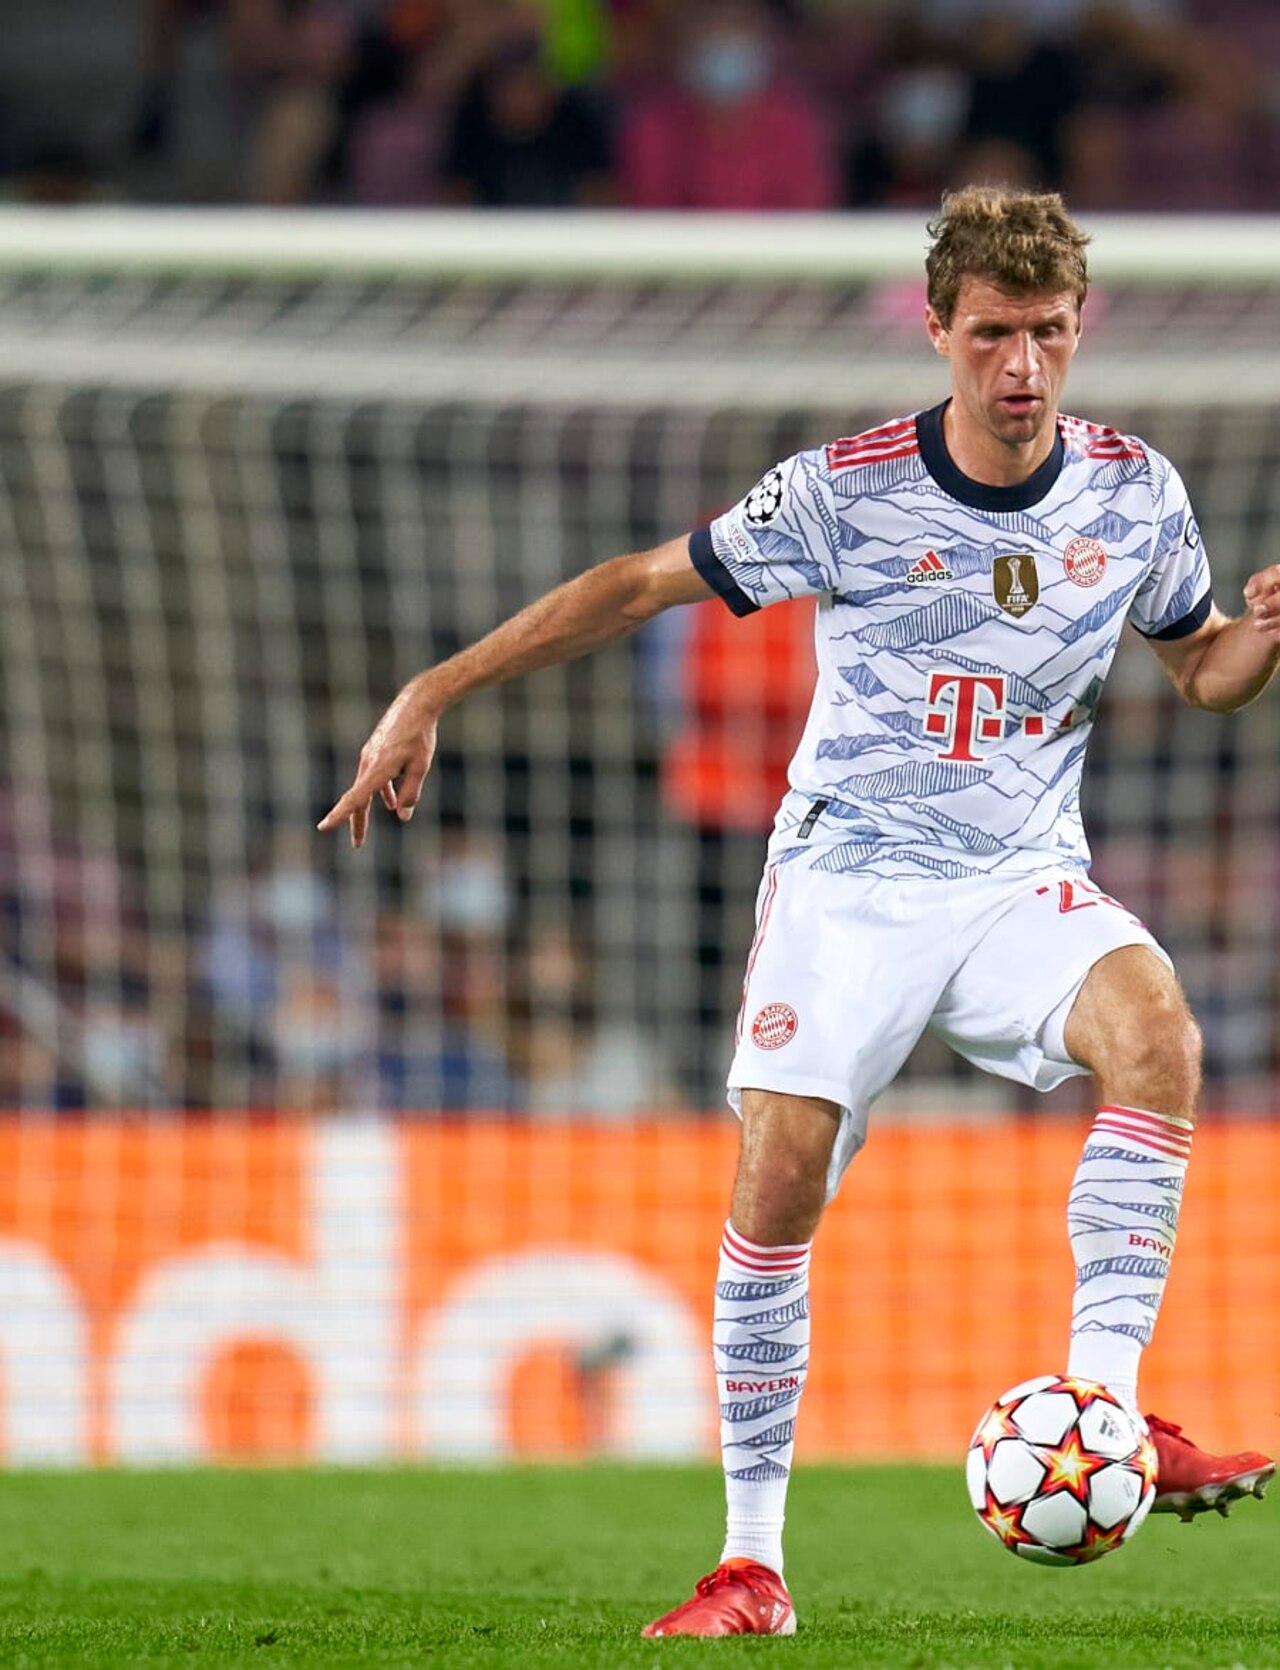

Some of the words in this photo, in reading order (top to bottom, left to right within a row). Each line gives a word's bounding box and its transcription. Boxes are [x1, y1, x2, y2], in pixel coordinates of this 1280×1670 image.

[906, 569, 953, 584] adidas
[1006, 594, 1029, 604] FIFA
[725, 1376, 799, 1392] BAYERN
